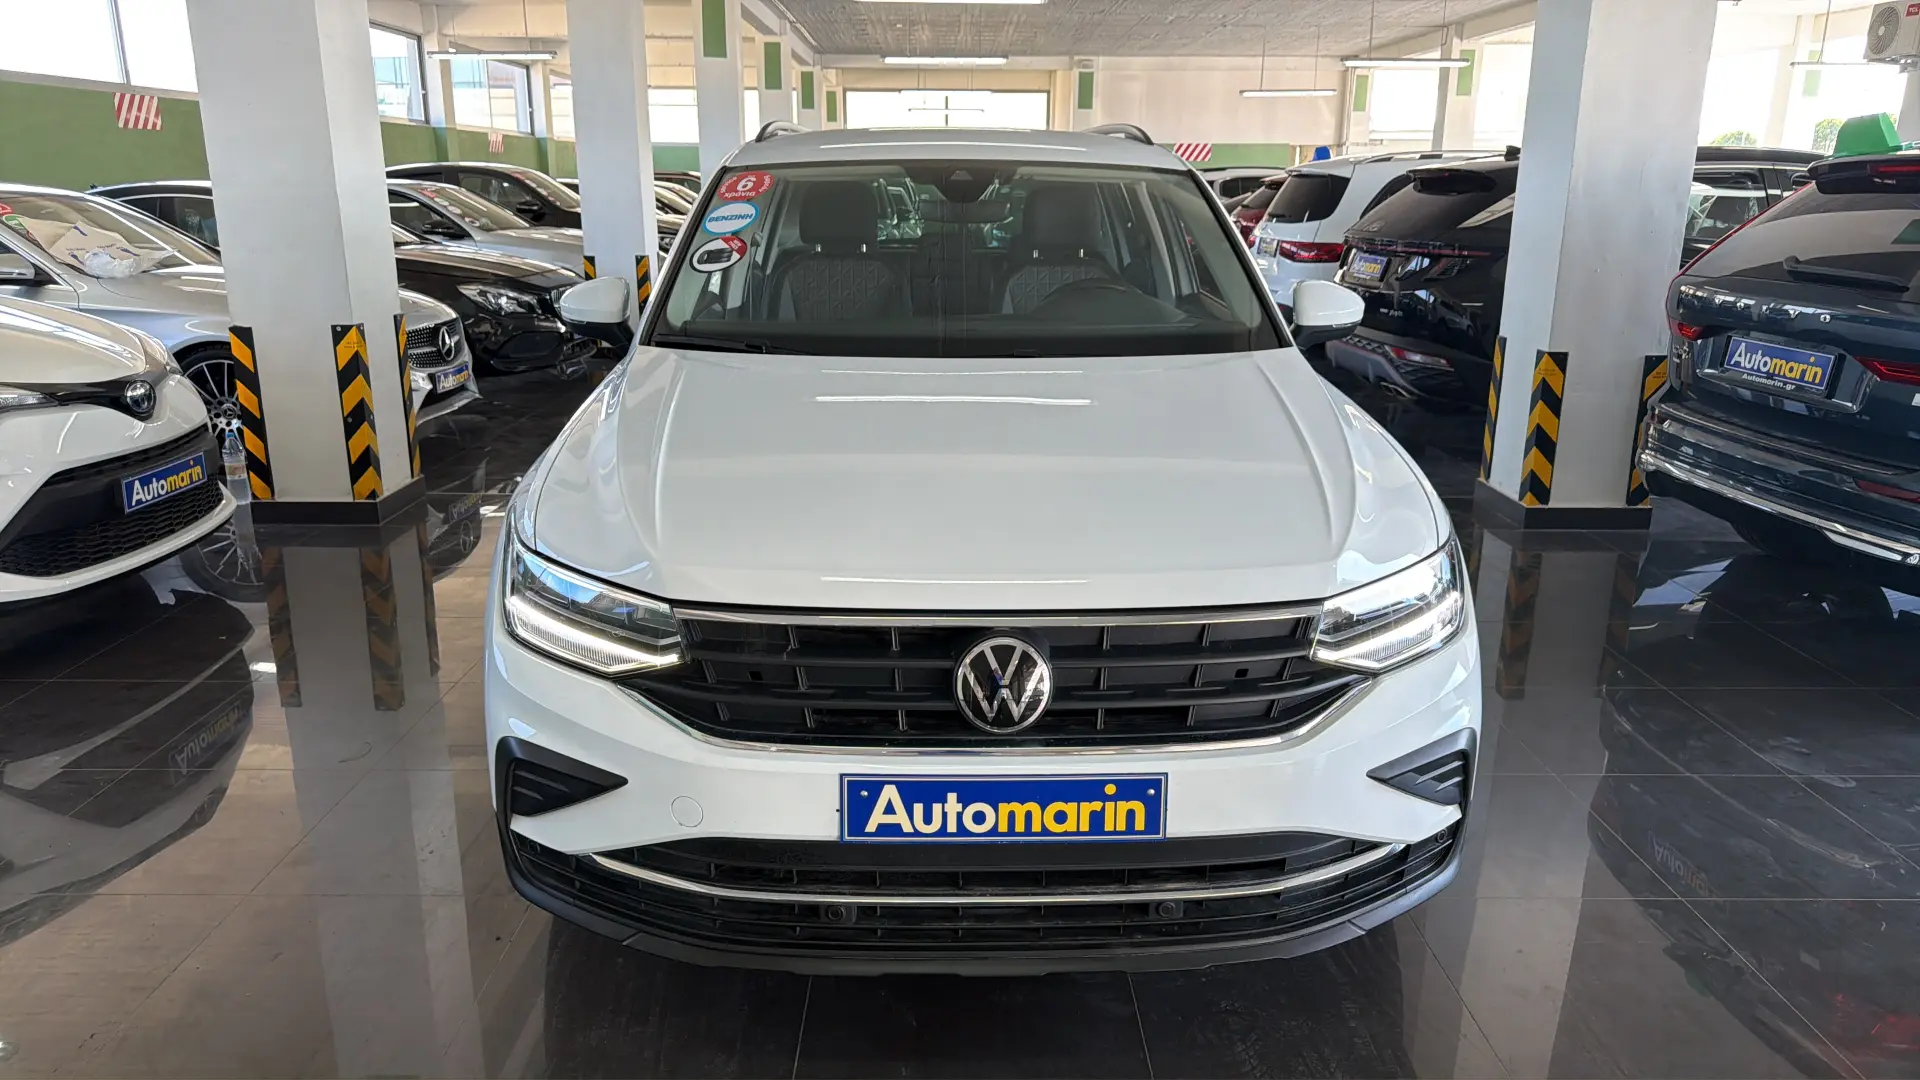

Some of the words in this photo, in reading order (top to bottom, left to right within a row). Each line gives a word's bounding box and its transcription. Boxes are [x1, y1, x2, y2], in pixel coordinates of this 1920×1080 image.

[736, 177, 757, 191] 6
[707, 213, 753, 222] ΒΕΝΖΙΝΗ
[1730, 342, 1823, 384] Automarin
[1741, 373, 1796, 390] Automarin.gr
[131, 460, 203, 506] Automarin
[864, 783, 1146, 834] Automarin
